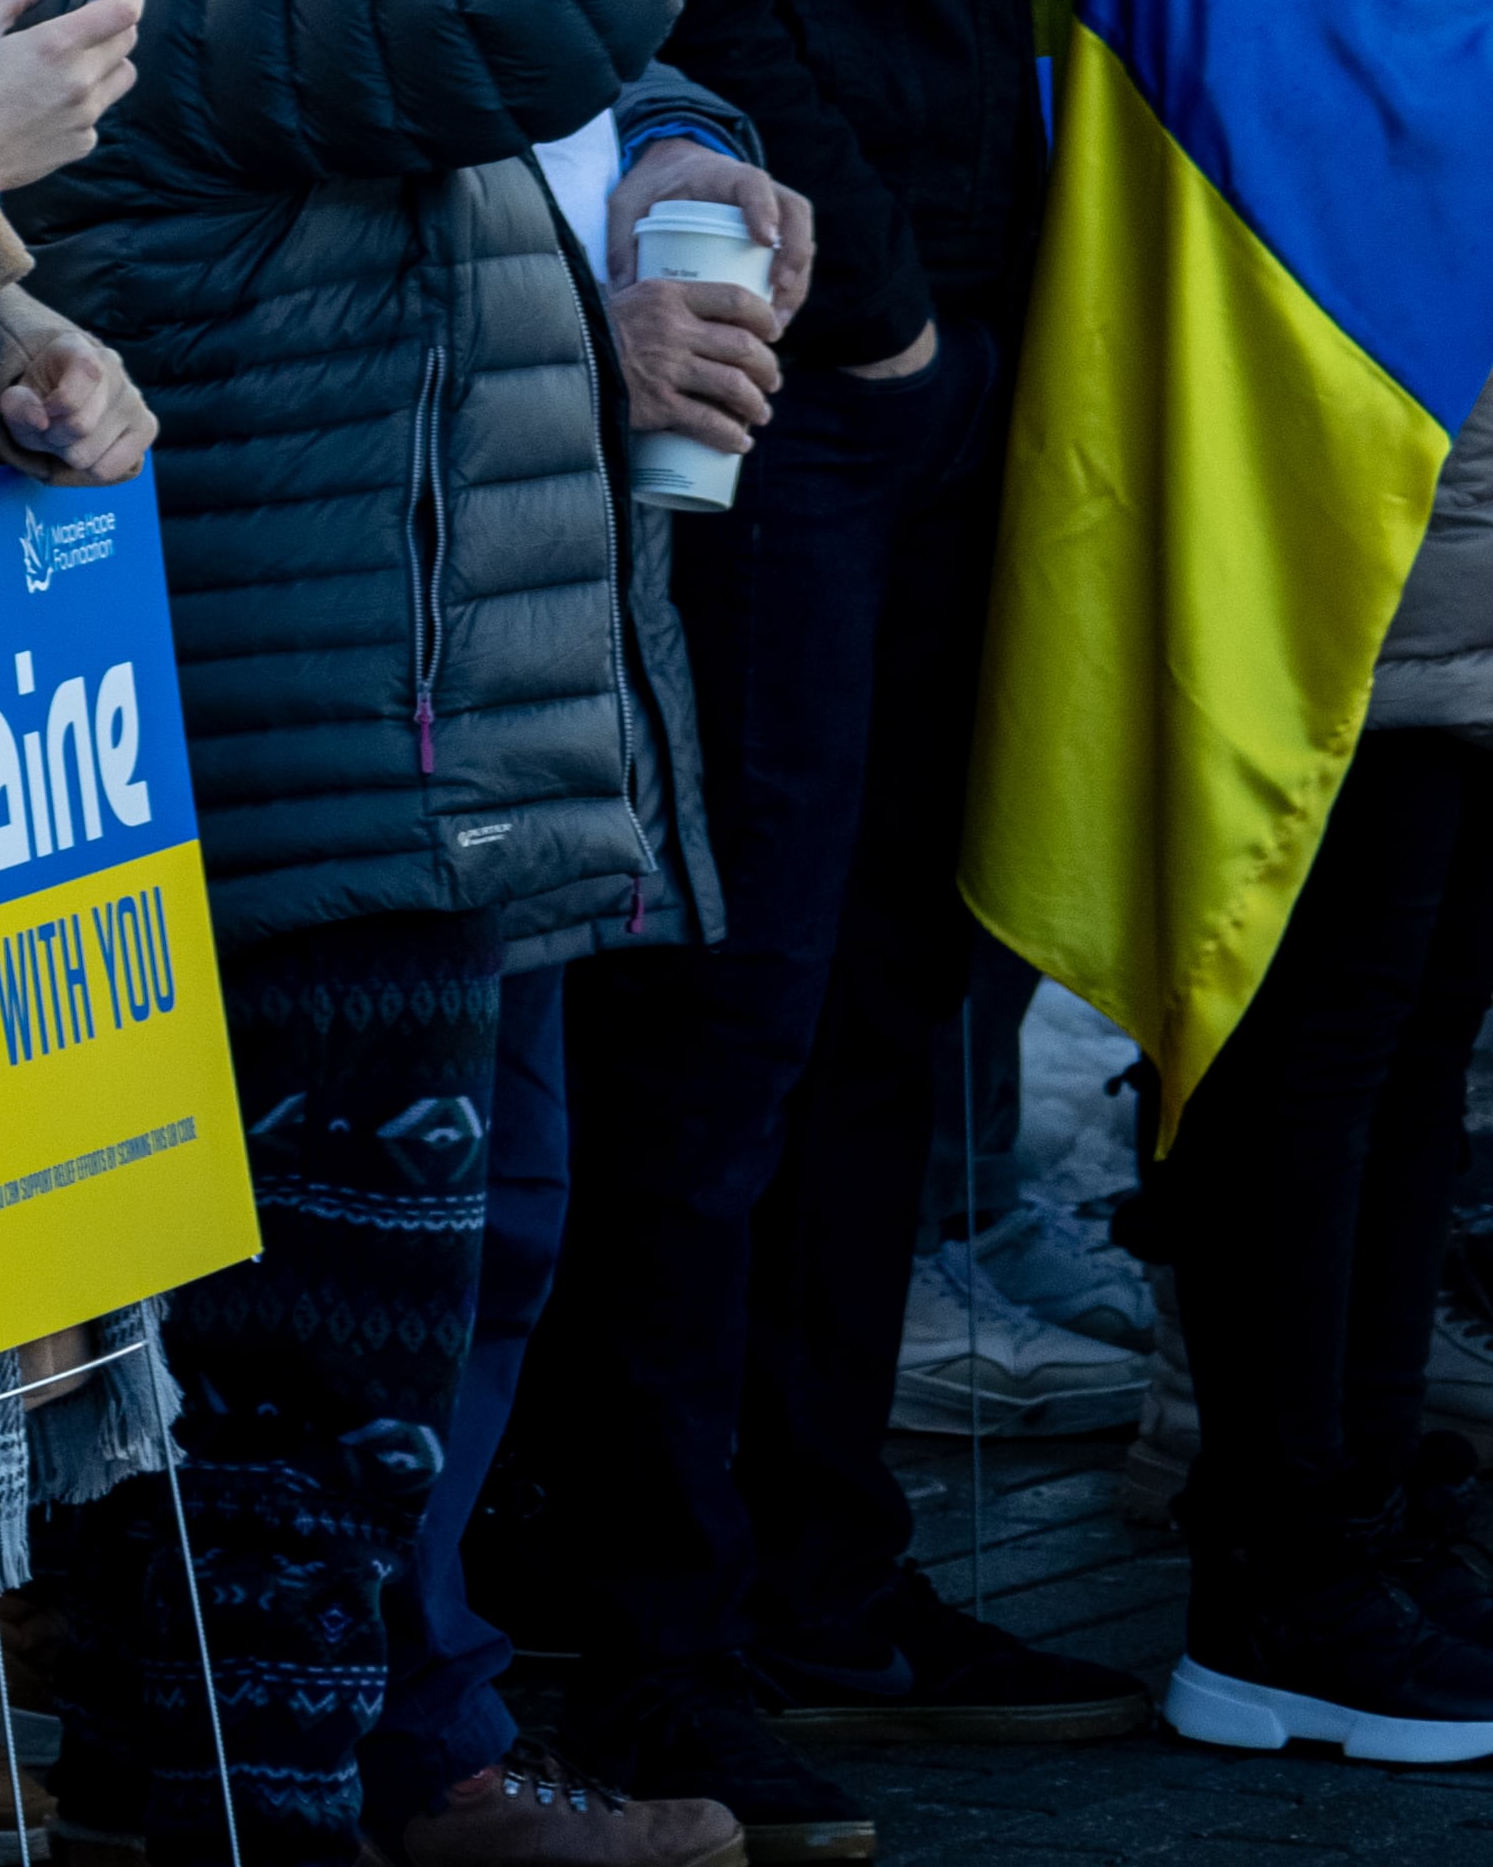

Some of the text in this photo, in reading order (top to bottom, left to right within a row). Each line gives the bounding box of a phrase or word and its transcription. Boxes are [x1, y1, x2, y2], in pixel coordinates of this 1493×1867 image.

[52, 512, 115, 547] Maple Hope
[53, 537, 113, 572] Foundation
[91, 885, 175, 1030] YOU
